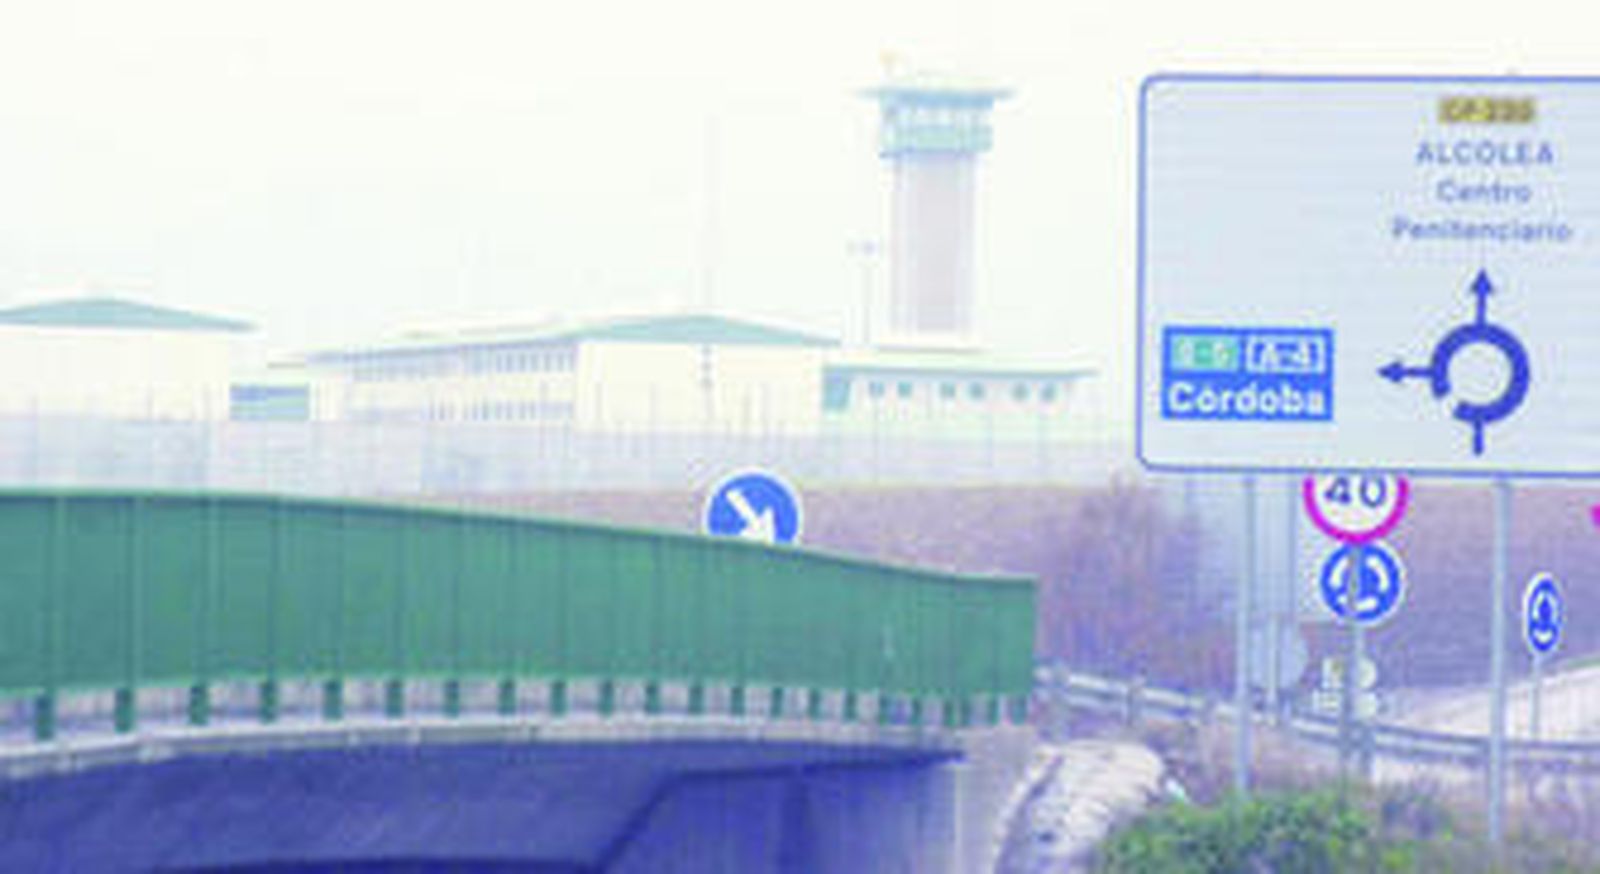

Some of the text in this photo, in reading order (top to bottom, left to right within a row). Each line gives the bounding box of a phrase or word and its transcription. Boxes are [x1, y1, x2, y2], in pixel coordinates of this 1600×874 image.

[1416, 142, 1554, 165] ALCOLEA
[1437, 180, 1532, 203] Centro
[1393, 216, 1573, 240] Penitenciario
[1324, 476, 1387, 507] 40
